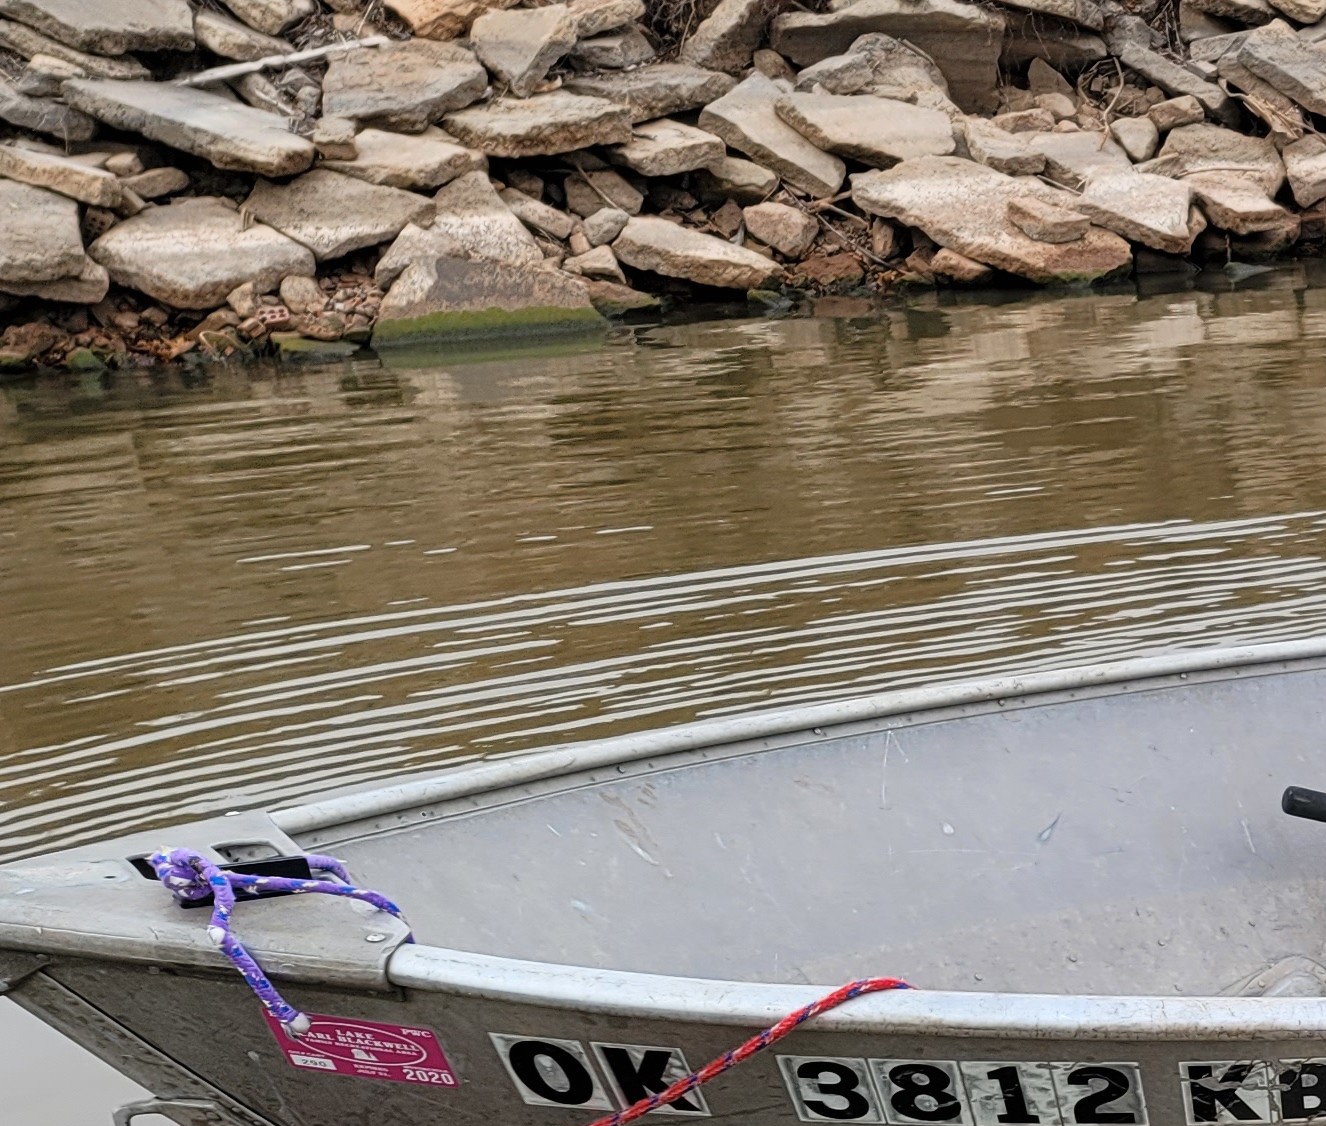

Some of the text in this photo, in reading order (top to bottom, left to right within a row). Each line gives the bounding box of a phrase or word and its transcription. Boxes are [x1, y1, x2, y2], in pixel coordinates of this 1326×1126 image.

[335, 1029, 376, 1040] LAKE
[401, 1028, 432, 1039] PWC
[338, 1035, 420, 1051] BLACKWELL
[402, 1069, 455, 1085] 2020
[509, 1040, 702, 1112] OK
[797, 1061, 1136, 1124] 3812
